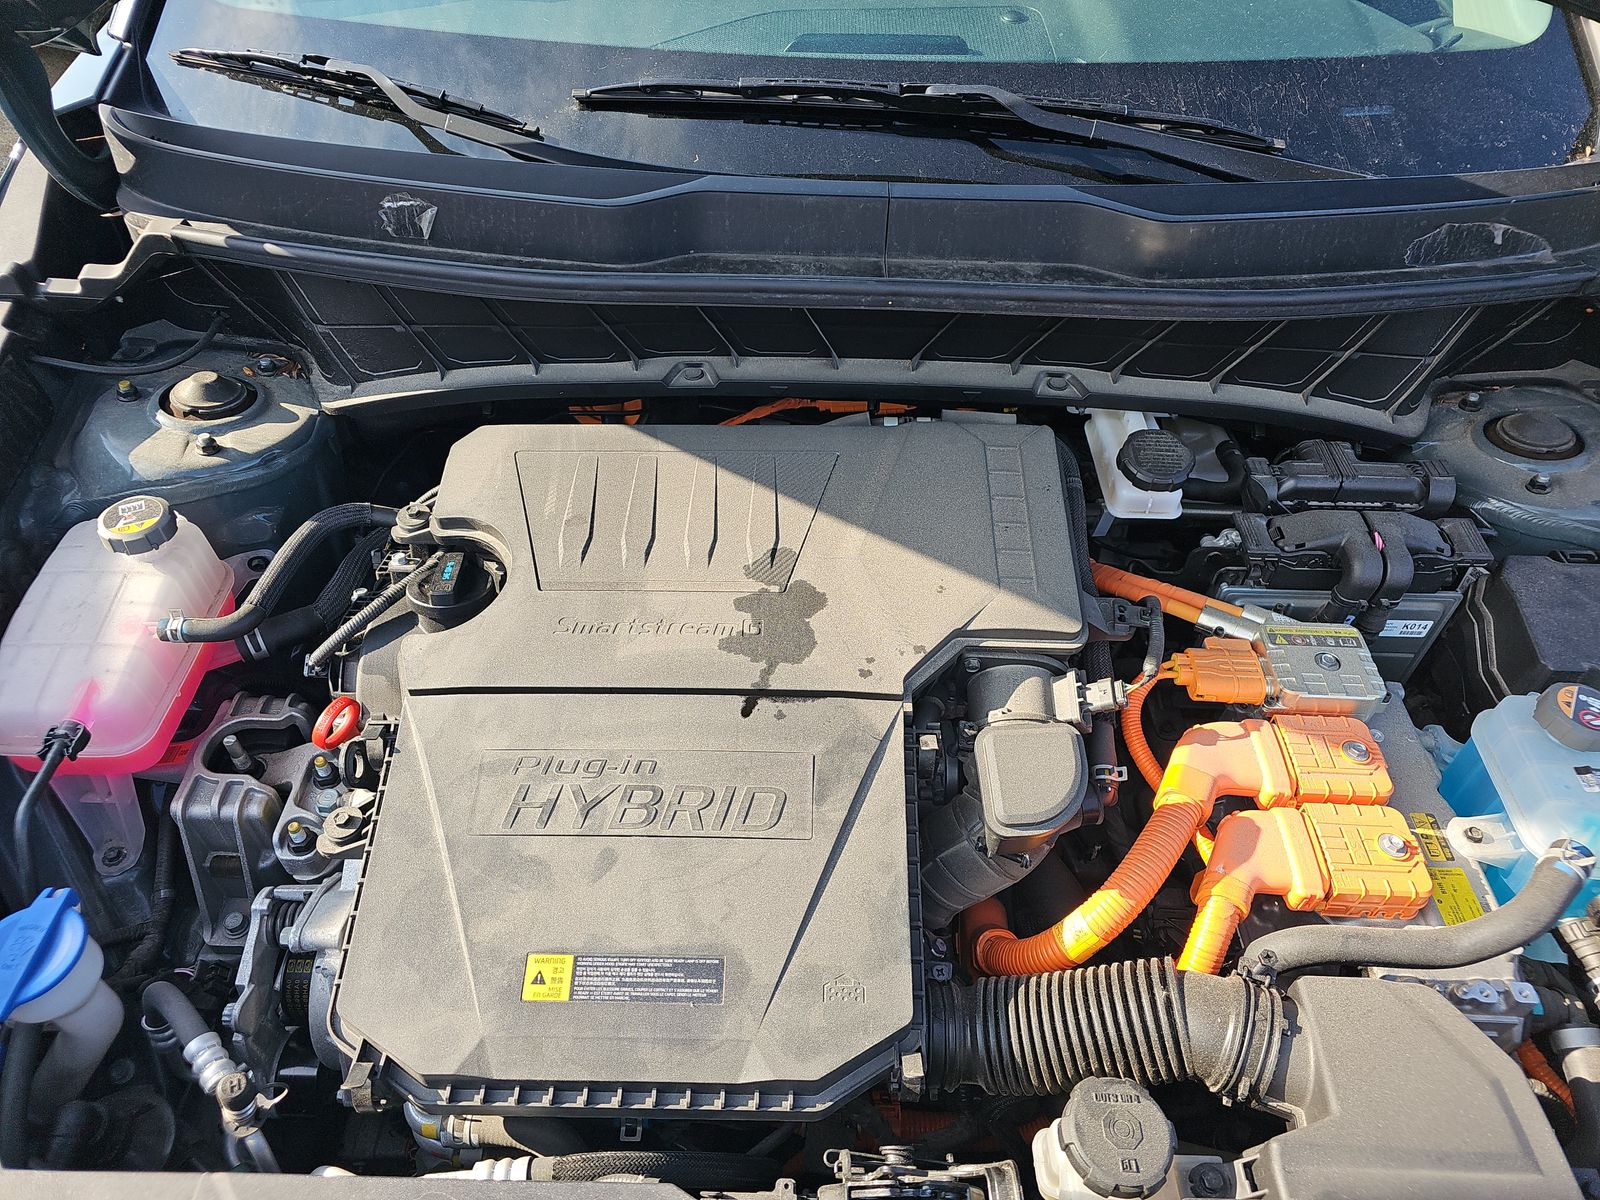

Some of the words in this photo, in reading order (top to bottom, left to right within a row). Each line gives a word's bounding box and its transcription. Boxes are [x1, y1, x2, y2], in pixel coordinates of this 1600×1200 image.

[553, 616, 739, 635] Smartstream
[1402, 622, 1428, 630] K014
[511, 754, 658, 779] Plug-in
[500, 783, 788, 832] HYBRID
[534, 957, 566, 965] WARNING
